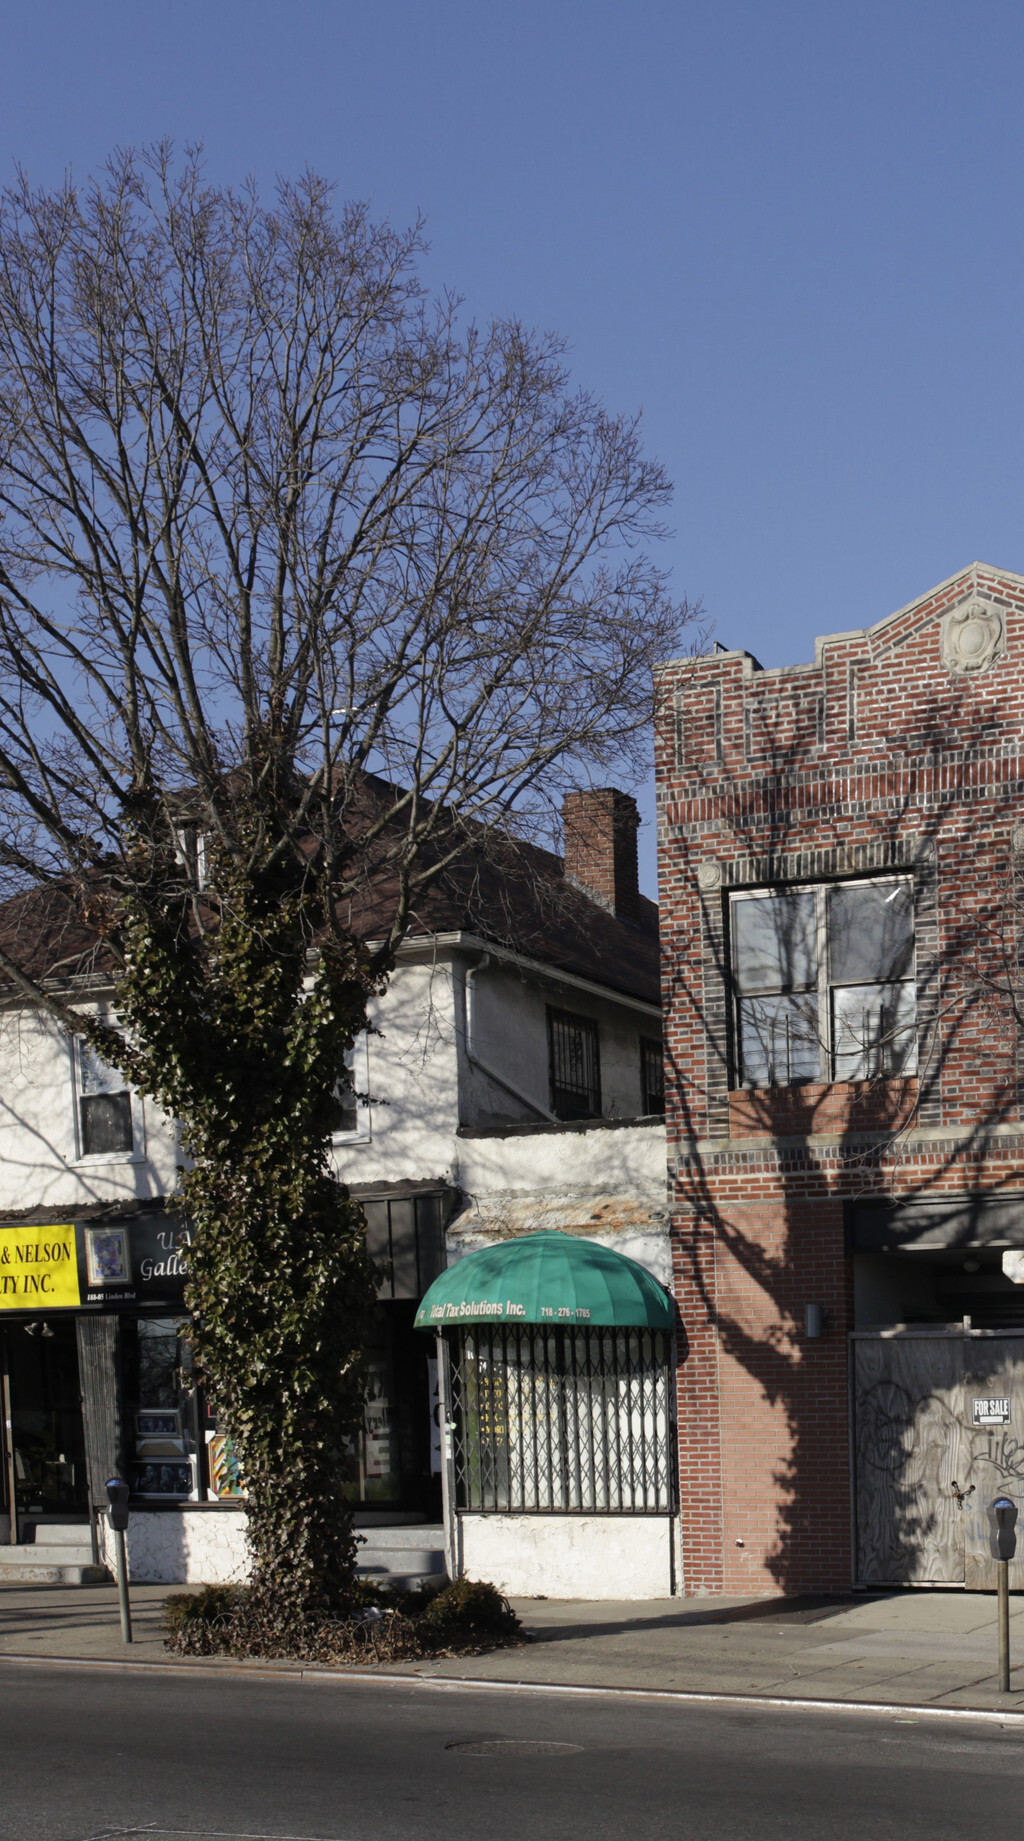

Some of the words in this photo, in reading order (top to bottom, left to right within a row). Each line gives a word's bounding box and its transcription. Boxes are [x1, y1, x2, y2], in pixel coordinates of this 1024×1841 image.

[1, 1246, 11, 1264] &
[15, 1242, 72, 1263] NELSON
[140, 1254, 190, 1281] Galle
[0, 1275, 19, 1294] TY
[23, 1273, 55, 1294] INC.
[430, 1304, 447, 1318] Total
[446, 1303, 460, 1318] Tax
[460, 1300, 503, 1316] Solutions
[506, 1300, 527, 1316] Inc.
[974, 1400, 989, 1416] FOR
[990, 1400, 1009, 1415] SALE
